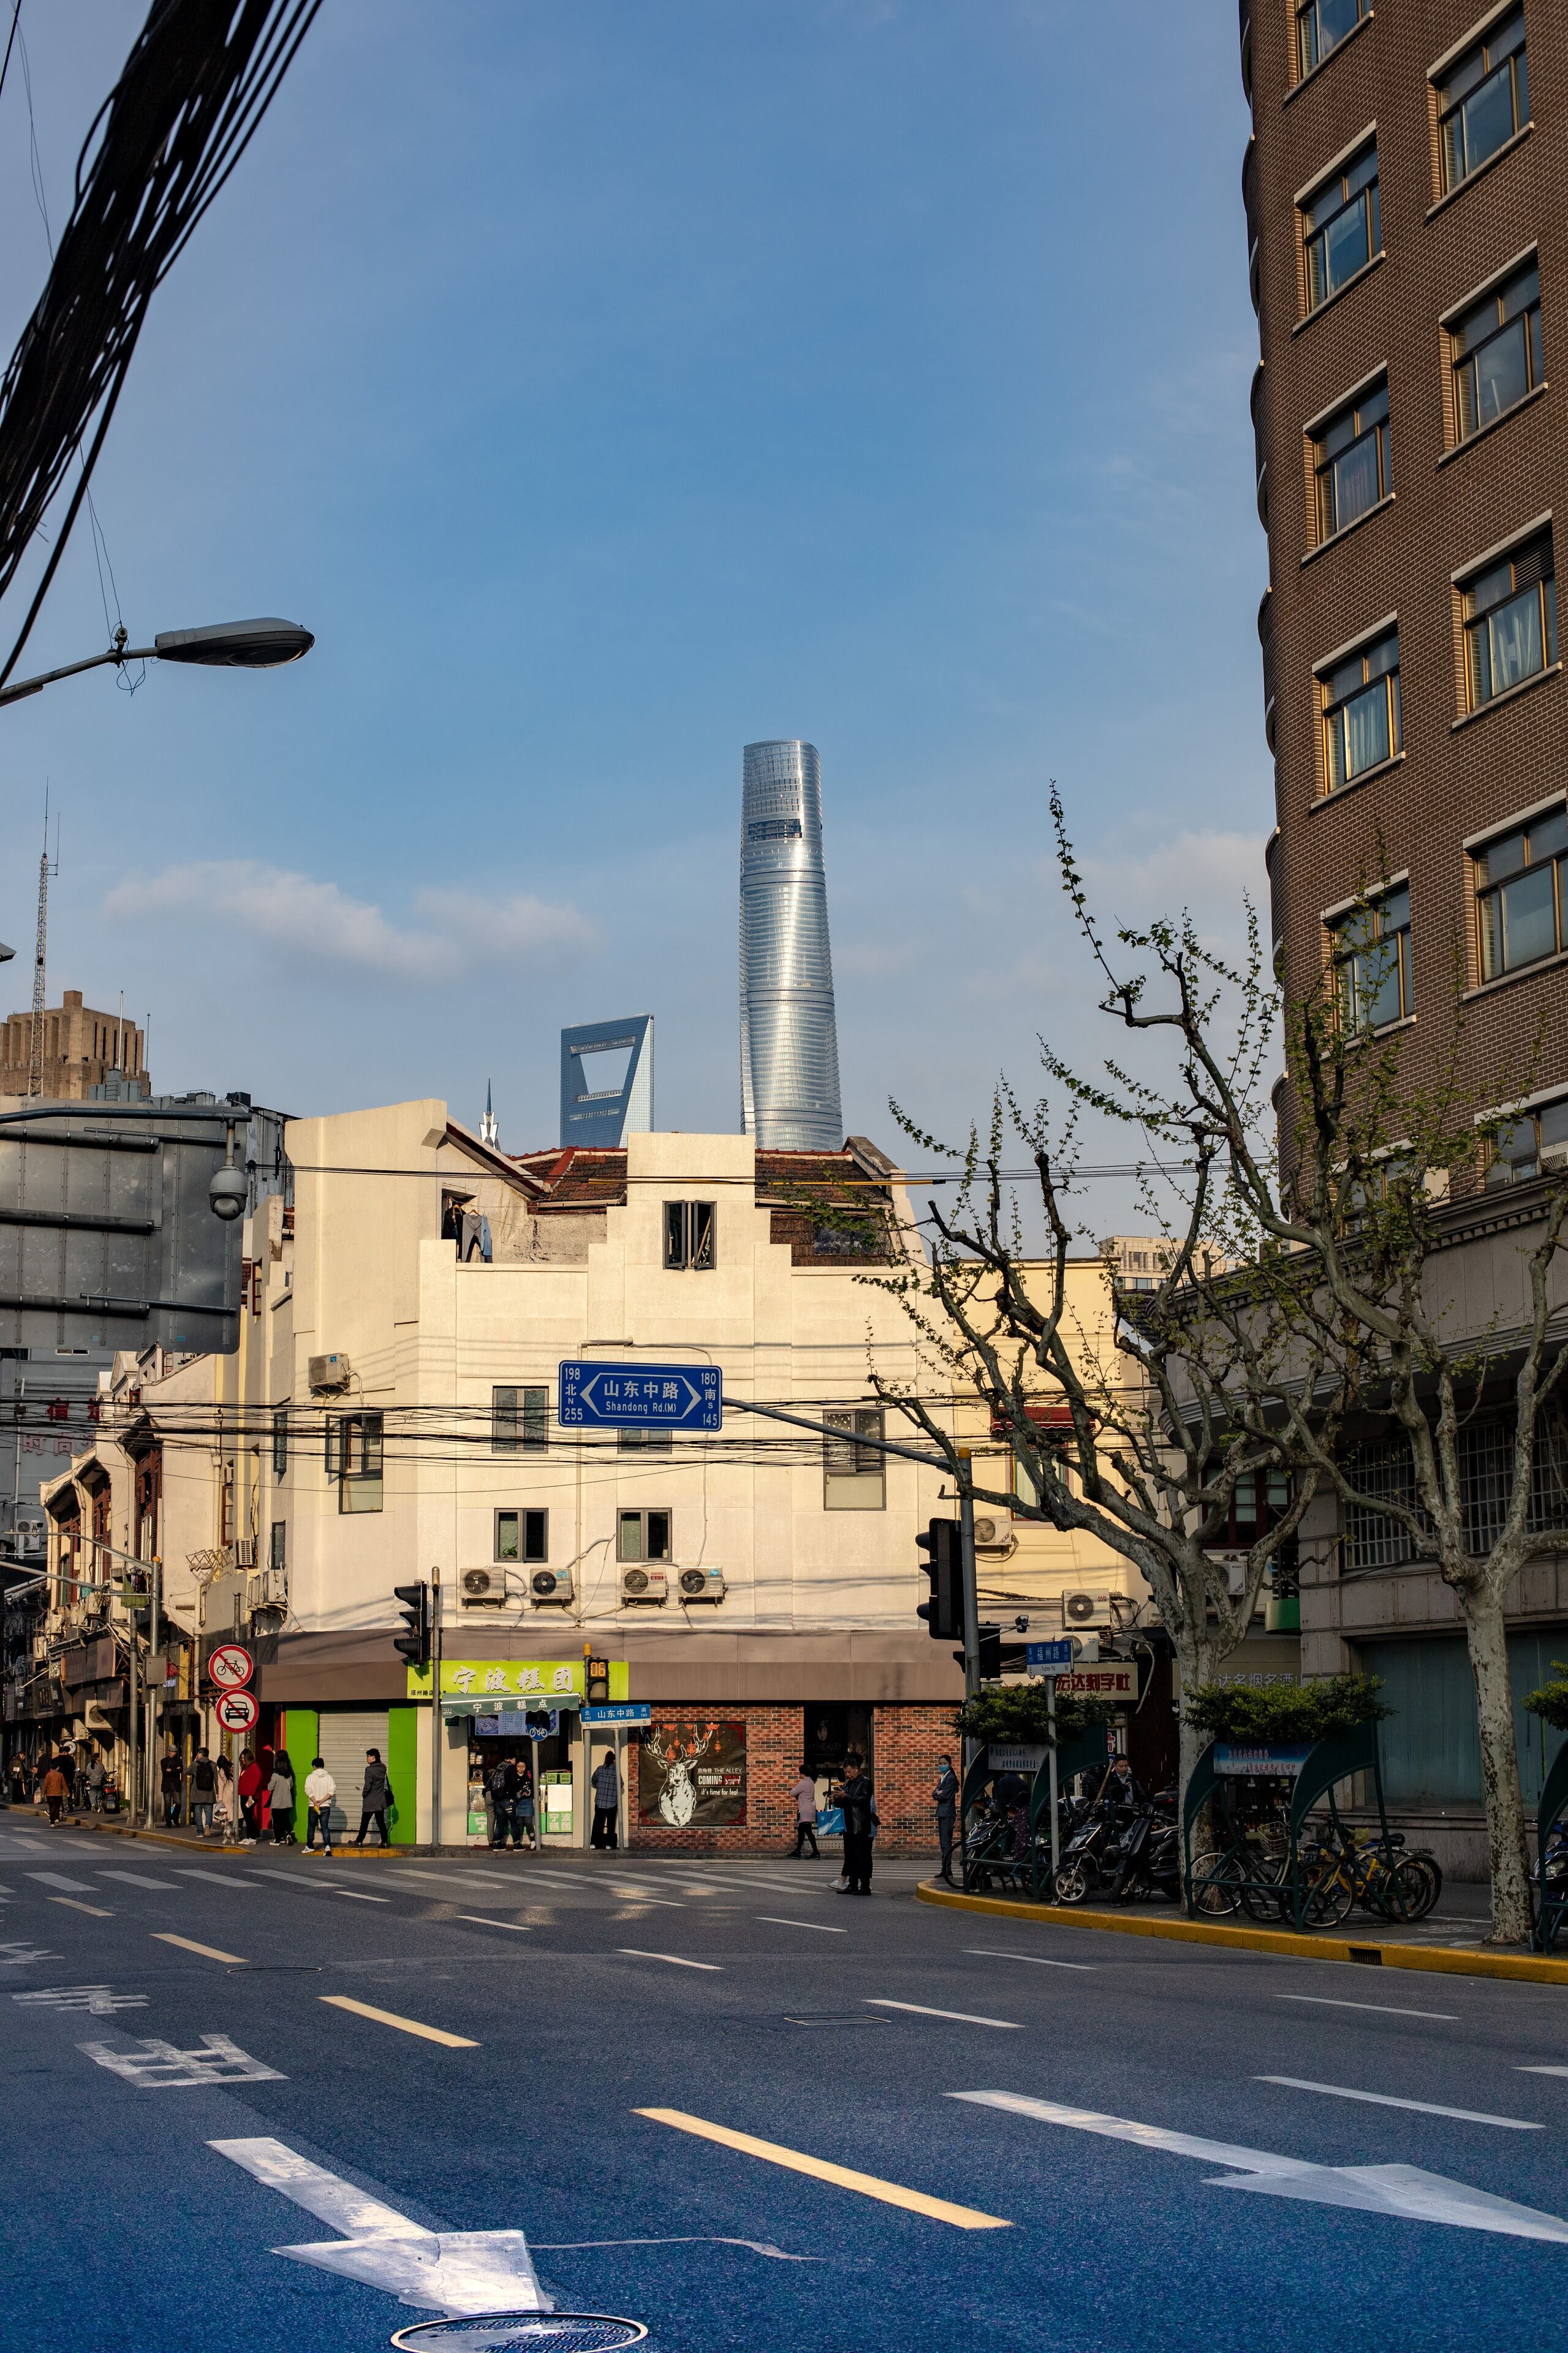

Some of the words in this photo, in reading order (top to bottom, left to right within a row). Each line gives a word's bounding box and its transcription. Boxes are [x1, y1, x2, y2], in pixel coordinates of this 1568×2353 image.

[565, 1367, 580, 1381] 198
[700, 1373, 716, 1385] 180
[565, 1384, 577, 1396] 北
[604, 1380, 680, 1400] 山东中路
[704, 1388, 716, 1401] 南
[564, 1408, 583, 1421] 255
[606, 1401, 648, 1415] Shandong
[653, 1403, 676, 1414] Rd.(M)
[703, 1413, 718, 1427] 145
[1037, 1645, 1059, 1661] 福州路
[590, 1662, 606, 1677] 06
[452, 1666, 574, 1694] 宁波糕团
[1056, 1673, 1131, 1691] 宏达刻字社
[472, 1699, 548, 1713] 宁波糕点
[597, 1708, 635, 1719] 山东中路
[698, 1775, 722, 1785] COMING
[549, 1813, 571, 1822] 宁波
